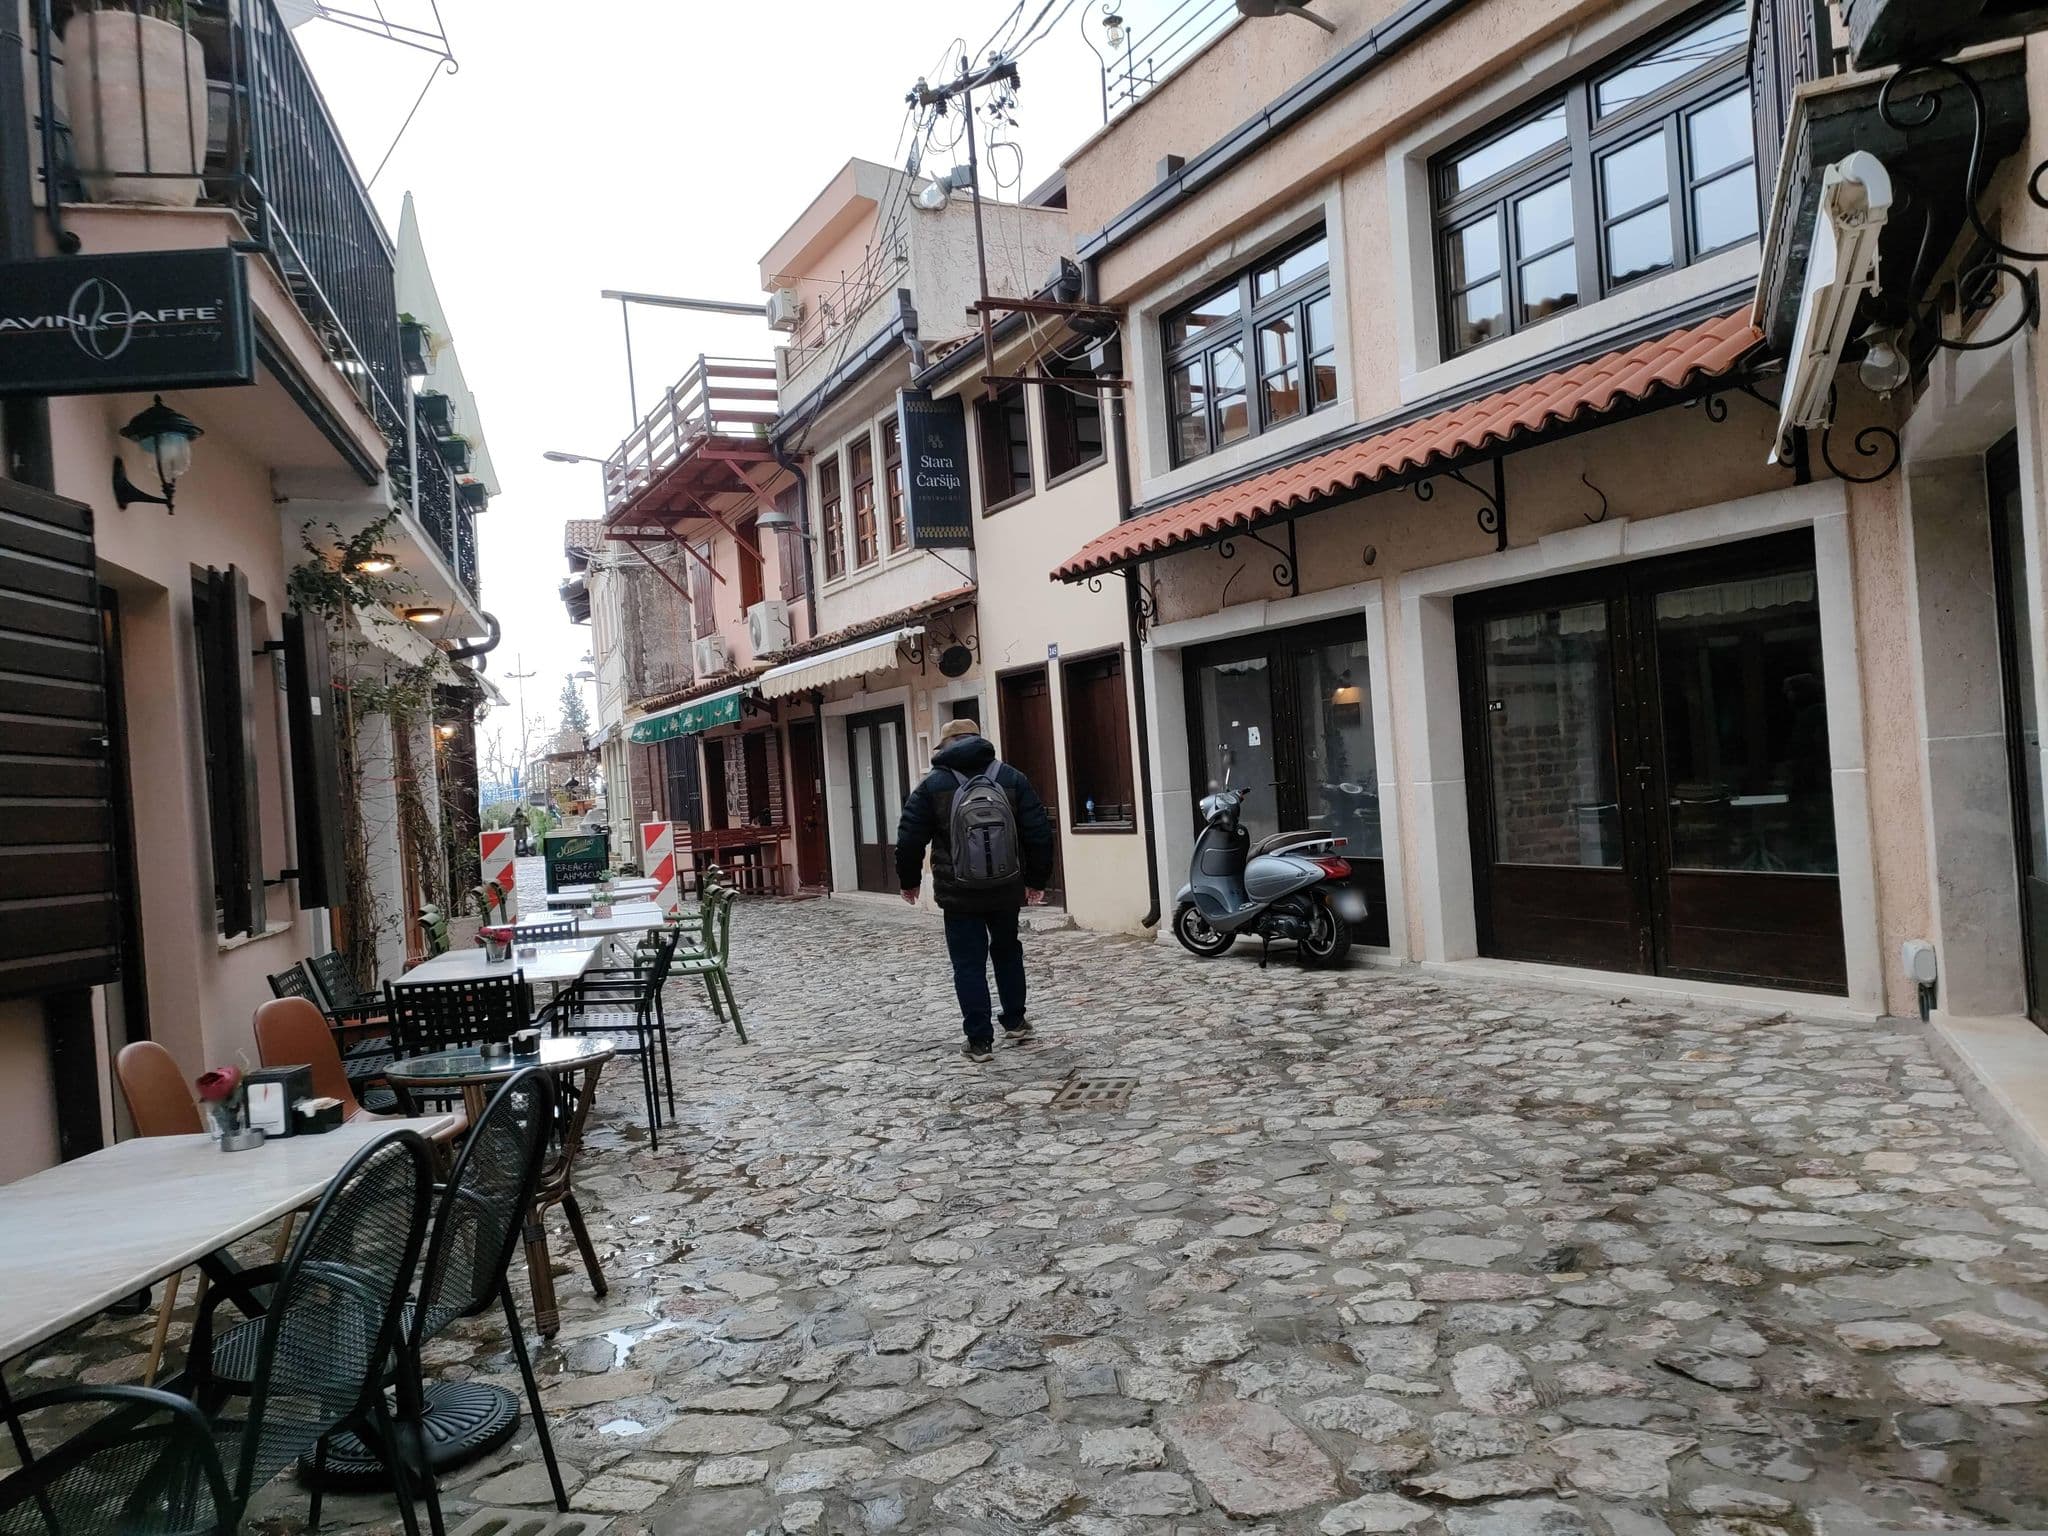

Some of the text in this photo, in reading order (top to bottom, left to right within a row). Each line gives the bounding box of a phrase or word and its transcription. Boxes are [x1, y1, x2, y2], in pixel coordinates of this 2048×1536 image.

[99, 307, 217, 325] CAFFE
[920, 454, 954, 468] Stara
[916, 472, 961, 490] Čaršija
